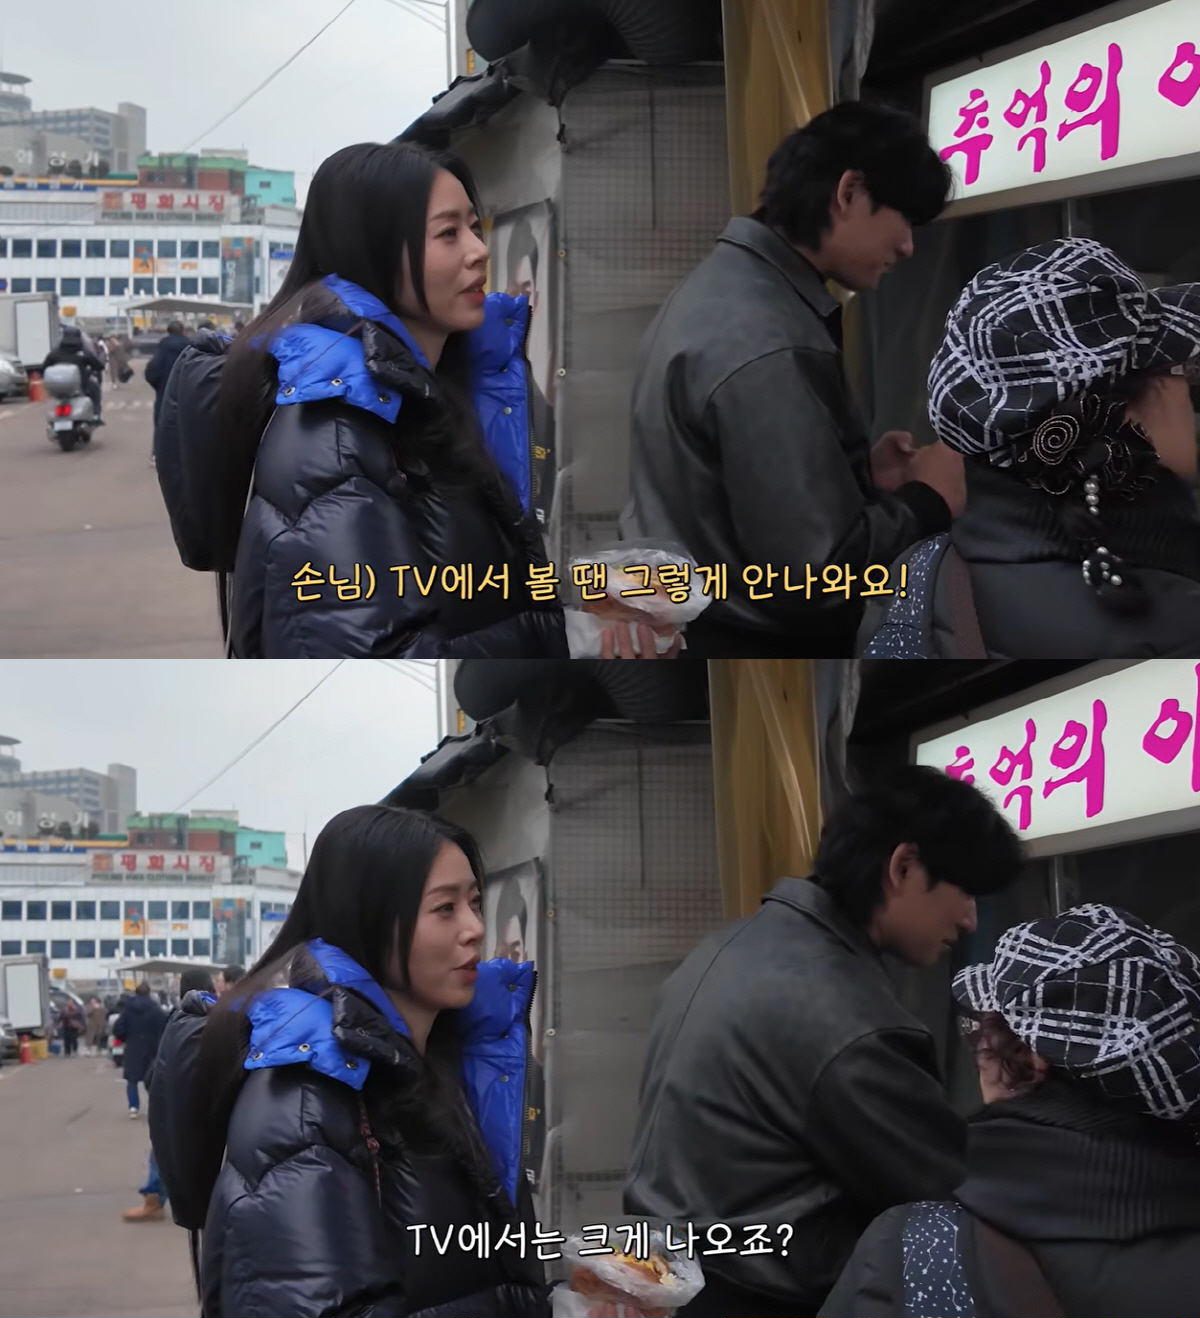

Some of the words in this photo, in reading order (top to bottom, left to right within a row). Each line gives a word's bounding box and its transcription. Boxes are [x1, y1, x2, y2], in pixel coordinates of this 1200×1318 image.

[938, 43, 1123, 186] 추억의
[131, 192, 224, 212] 평화시장
[121, 854, 215, 873] 평화시장
